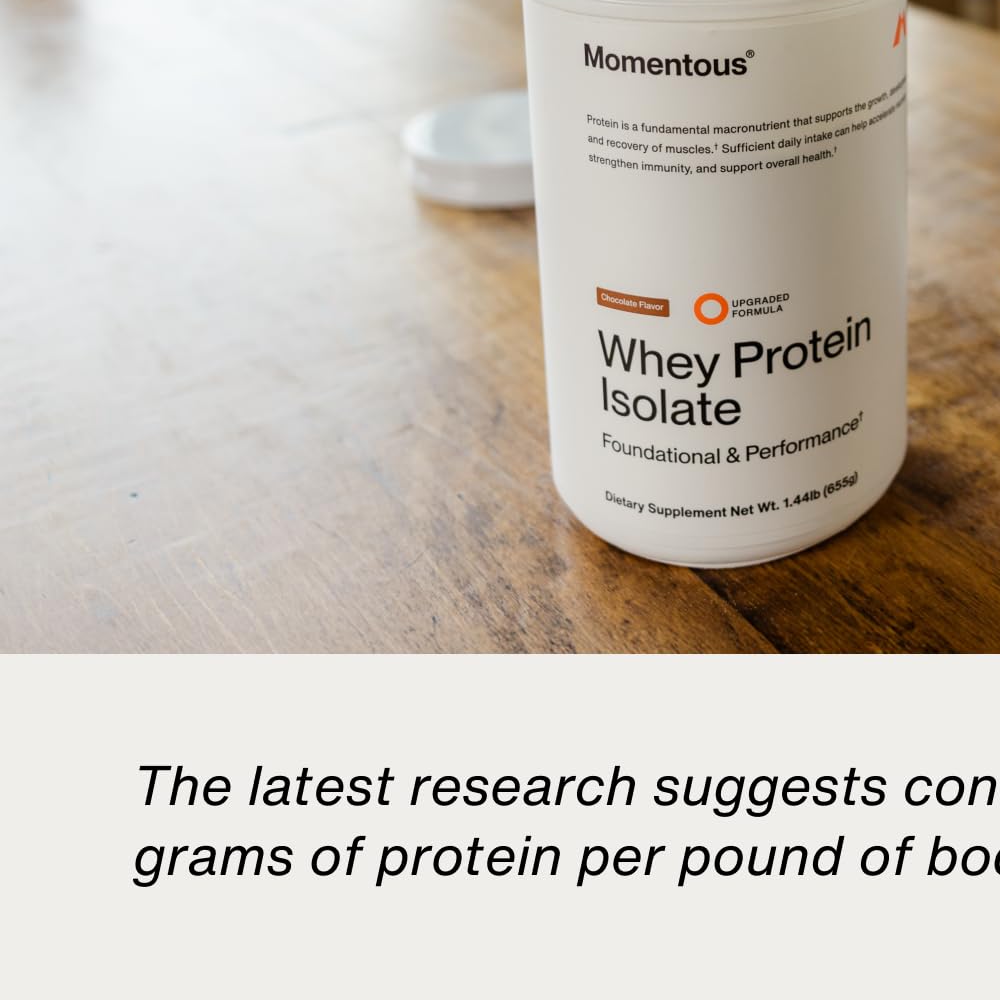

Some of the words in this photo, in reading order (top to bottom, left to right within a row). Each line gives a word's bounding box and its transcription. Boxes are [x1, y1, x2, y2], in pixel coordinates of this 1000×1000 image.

[587, 114, 619, 129] Protein
[621, 120, 630, 131] is
[632, 123, 639, 132] a
[641, 122, 710, 135] fundamental
[713, 119, 790, 134] macronutrient
[793, 116, 813, 127] that
[815, 106, 853, 124] supports
[854, 102, 867, 113] the
[587, 135, 604, 145] and
[606, 139, 649, 154] recovery
[651, 143, 662, 153] of
[721, 141, 775, 154] Sufficient
[777, 136, 802, 149] daily
[804, 131, 833, 145] intake
[834, 126, 850, 138] can
[851, 120, 868, 132] help
[588, 153, 639, 170] strengthen
[641, 161, 693, 175] immunity,
[695, 163, 717, 173] and
[719, 160, 763, 174] support
[765, 155, 800, 170] overall
[600, 292, 638, 308] Chocolate
[639, 301, 664, 311] Flavor
[732, 293, 790, 308] UPGRADED
[732, 304, 783, 318] FORMULA
[598, 329, 720, 388] Whey
[734, 316, 871, 378] Protein
[602, 376, 742, 426] Isolate
[602, 432, 720, 464] Foundational
[726, 447, 740, 463] &
[605, 490, 645, 513] Dietary
[647, 503, 727, 519] Supplement
[730, 505, 754, 517] Net
[758, 501, 779, 513] Wt.
[784, 489, 820, 508] 1.44lb
[823, 471, 858, 498] (655g)
